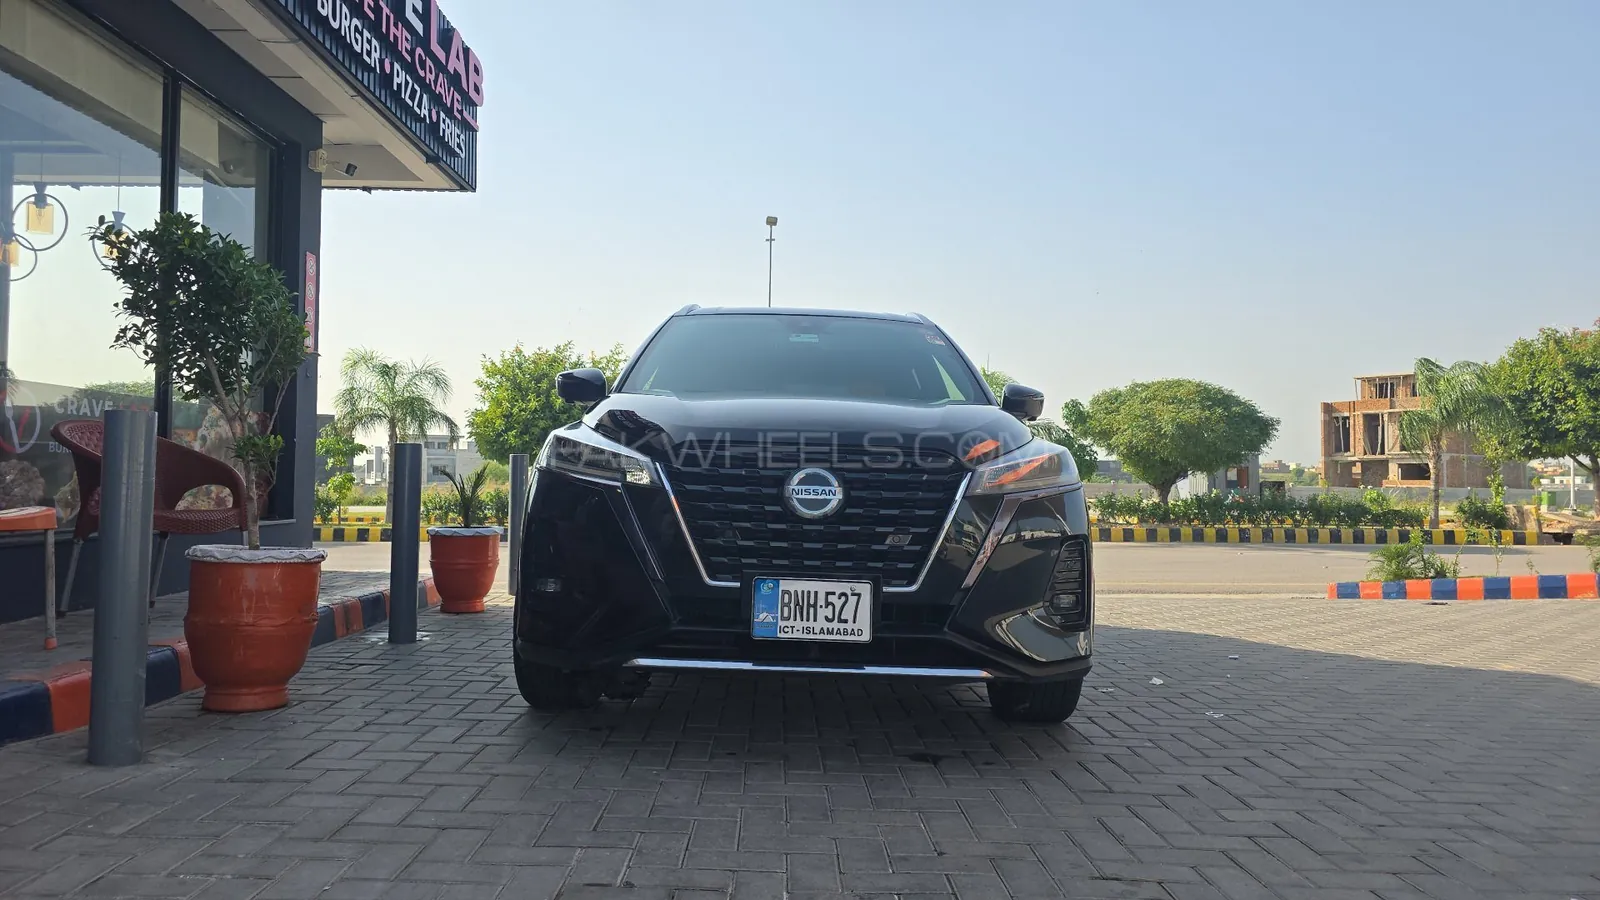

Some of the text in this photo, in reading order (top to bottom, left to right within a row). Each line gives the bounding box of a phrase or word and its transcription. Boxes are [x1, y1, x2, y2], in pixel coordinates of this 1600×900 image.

[379, 0, 412, 63] THE
[415, 47, 462, 120] CRAVE
[430, 0, 484, 107] LAB
[393, 62, 430, 123] PIZZA
[439, 111, 466, 159] FRIES
[54, 396, 114, 417] CRAVE
[791, 488, 837, 497] NISSAN
[778, 625, 864, 637] ICT-ISLAMABAD
